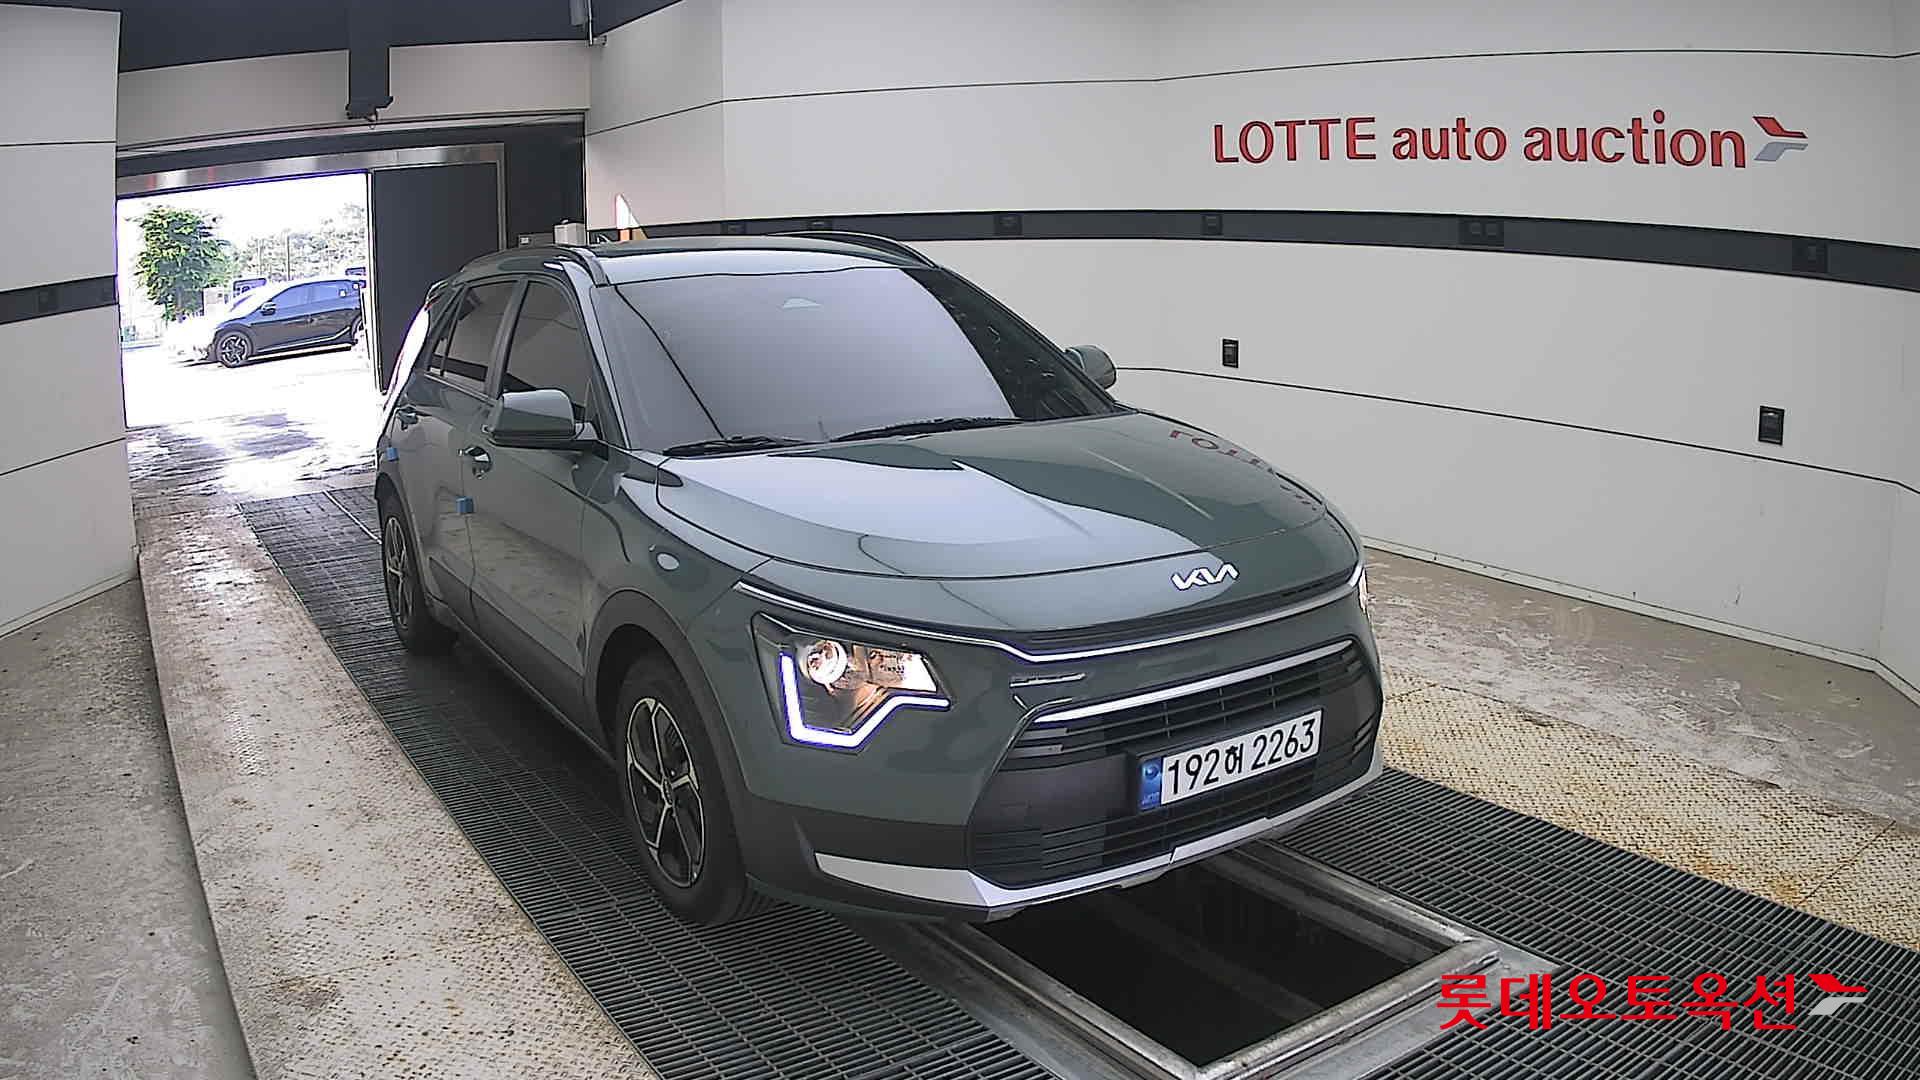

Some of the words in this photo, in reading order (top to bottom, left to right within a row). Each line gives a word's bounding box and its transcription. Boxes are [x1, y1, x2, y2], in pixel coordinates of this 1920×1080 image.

[1213, 117, 1377, 164] LOTTE
[1392, 117, 1507, 161] auto
[1523, 109, 1746, 168] auction
[1170, 562, 1240, 591] KIA
[1167, 743, 1244, 795] 192허
[1251, 718, 1316, 771] 2263
